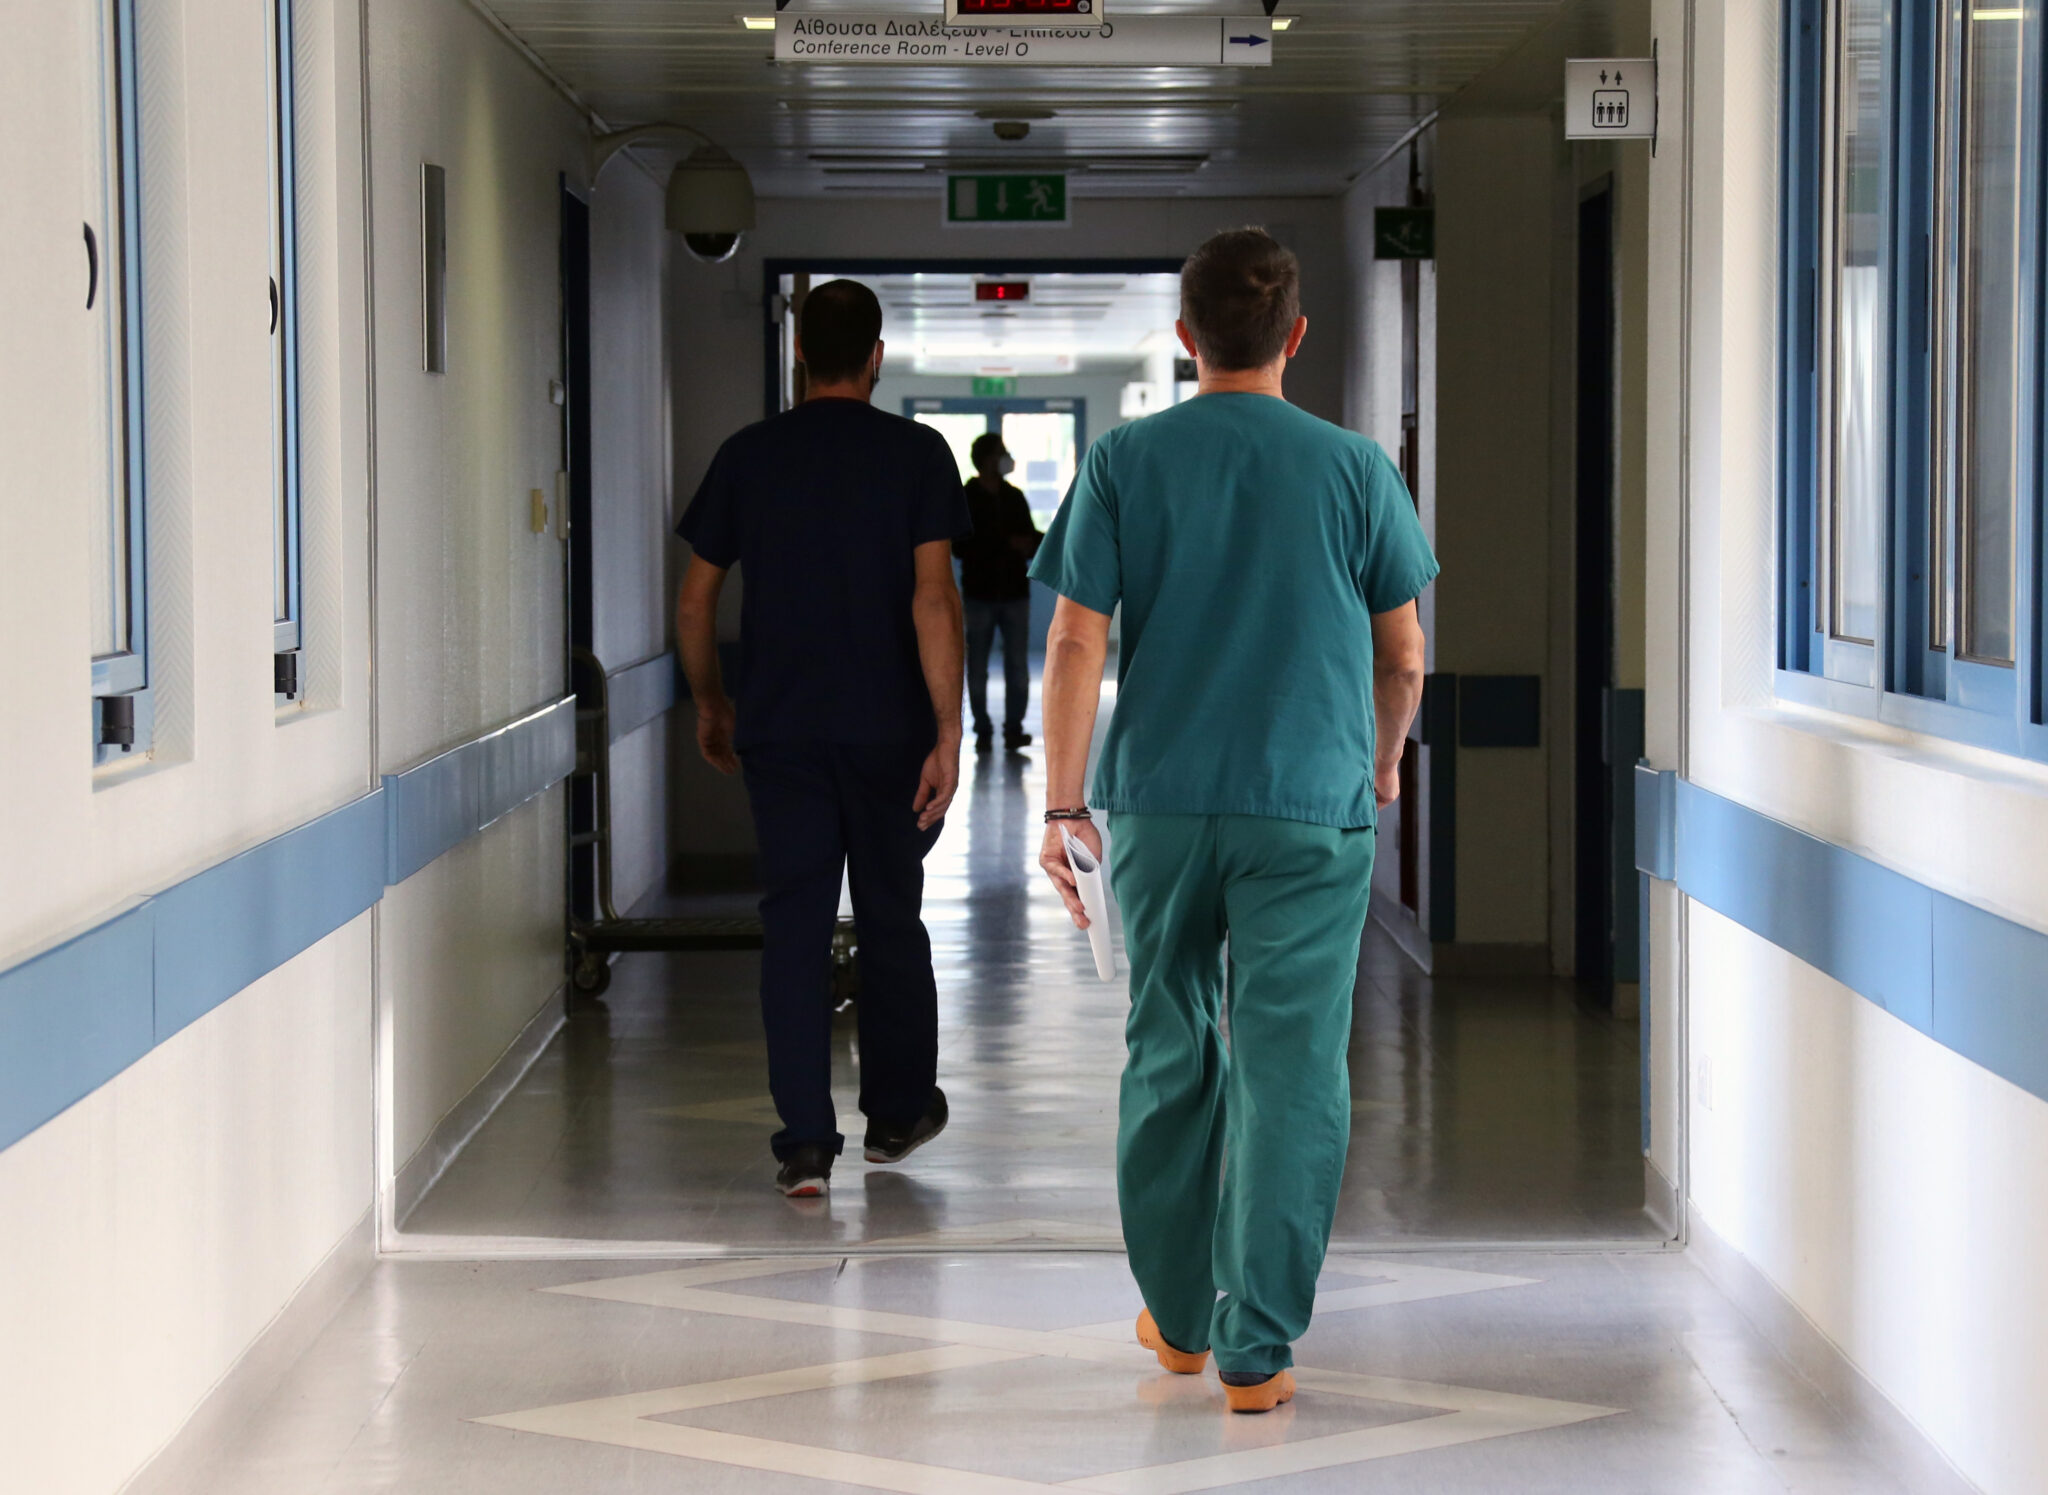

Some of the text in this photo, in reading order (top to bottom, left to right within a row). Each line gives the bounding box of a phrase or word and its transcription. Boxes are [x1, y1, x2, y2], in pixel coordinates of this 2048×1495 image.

[793, 18, 877, 35] Αίθουσα
[793, 39, 891, 54] Conference
[897, 40, 947, 55] Room
[965, 42, 1010, 56] Level
